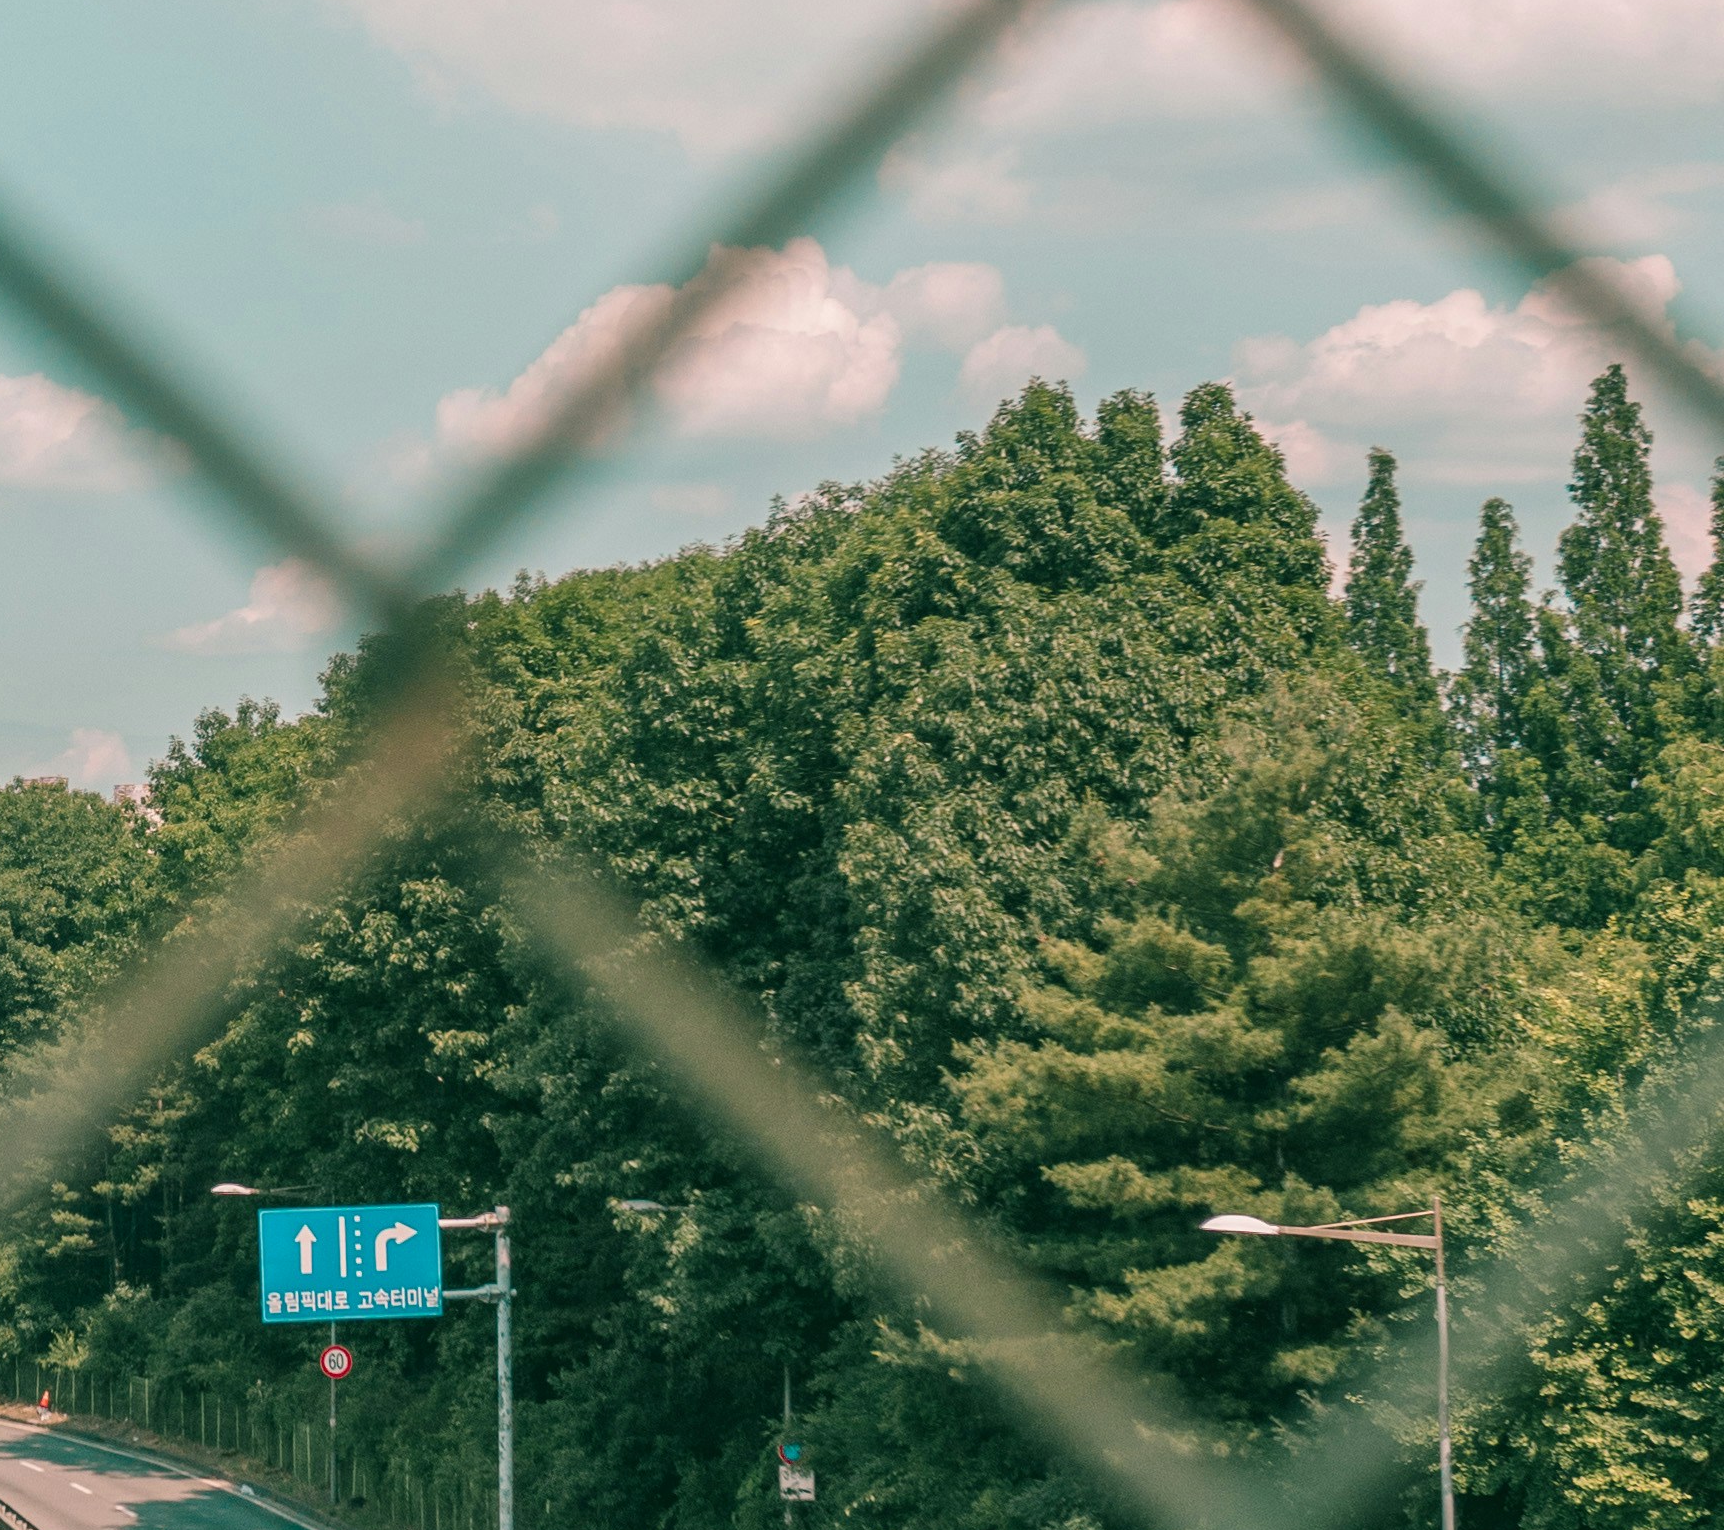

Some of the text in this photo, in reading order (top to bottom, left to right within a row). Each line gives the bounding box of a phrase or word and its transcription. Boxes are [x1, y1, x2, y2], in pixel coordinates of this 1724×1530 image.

[266, 1286, 439, 1314] 올림픽대로 고속터미널
[329, 1353, 344, 1370] 60
